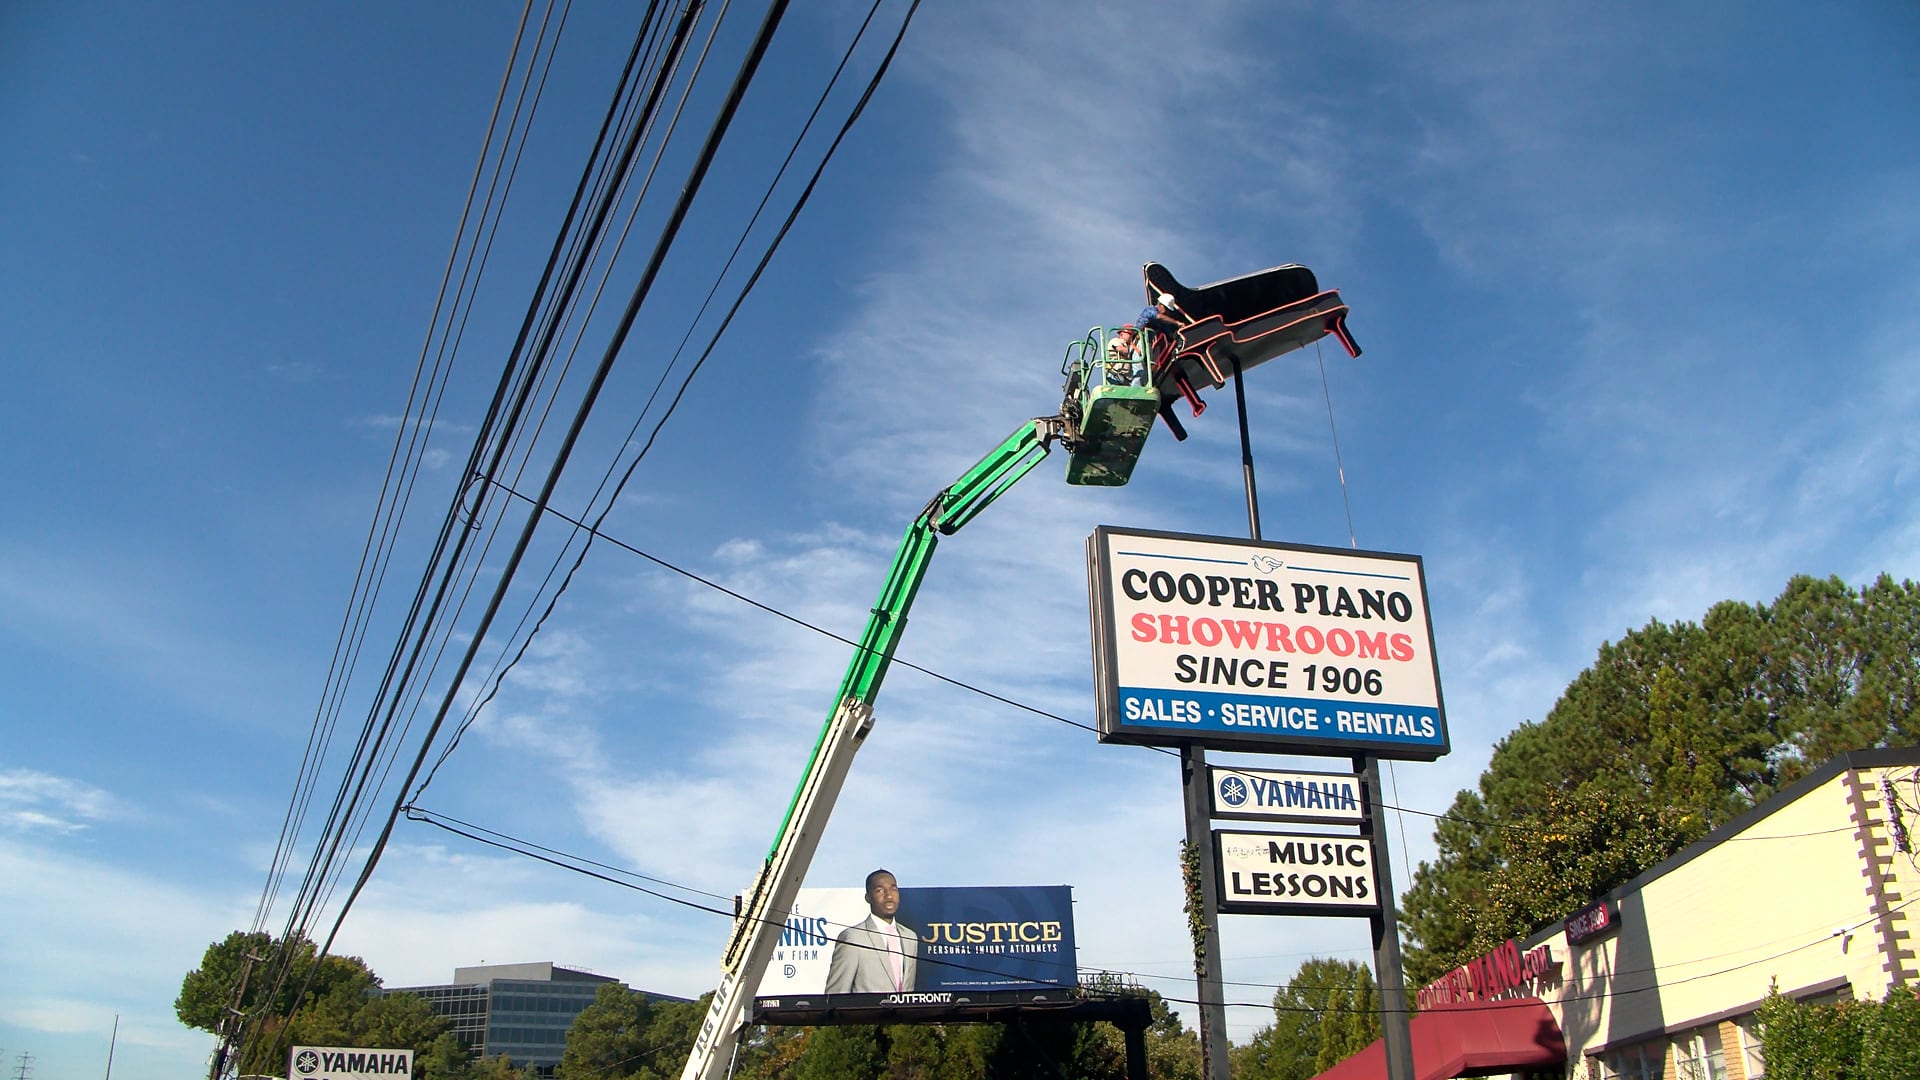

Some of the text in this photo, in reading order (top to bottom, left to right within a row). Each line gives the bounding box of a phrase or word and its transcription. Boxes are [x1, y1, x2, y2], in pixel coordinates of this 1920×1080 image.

[1122, 568, 1412, 623] COOPER PIANO
[1131, 612, 1415, 662] SHOWROOMS
[1175, 654, 1383, 696] SINCE 1906
[1125, 697, 1436, 738] SALES SERVICE RENTALS
[1250, 778, 1357, 811] YAMAHA
[1268, 841, 1367, 866] MUSIC
[1231, 872, 1369, 899] LESSONS
[778, 917, 828, 947] NNIS
[921, 921, 1062, 943] JUSTICE
[792, 950, 818, 961] FIRM
[927, 943, 1058, 955] PERSONAL INJURY ATTORNEYS
[321, 1052, 408, 1074] YAMAHA
